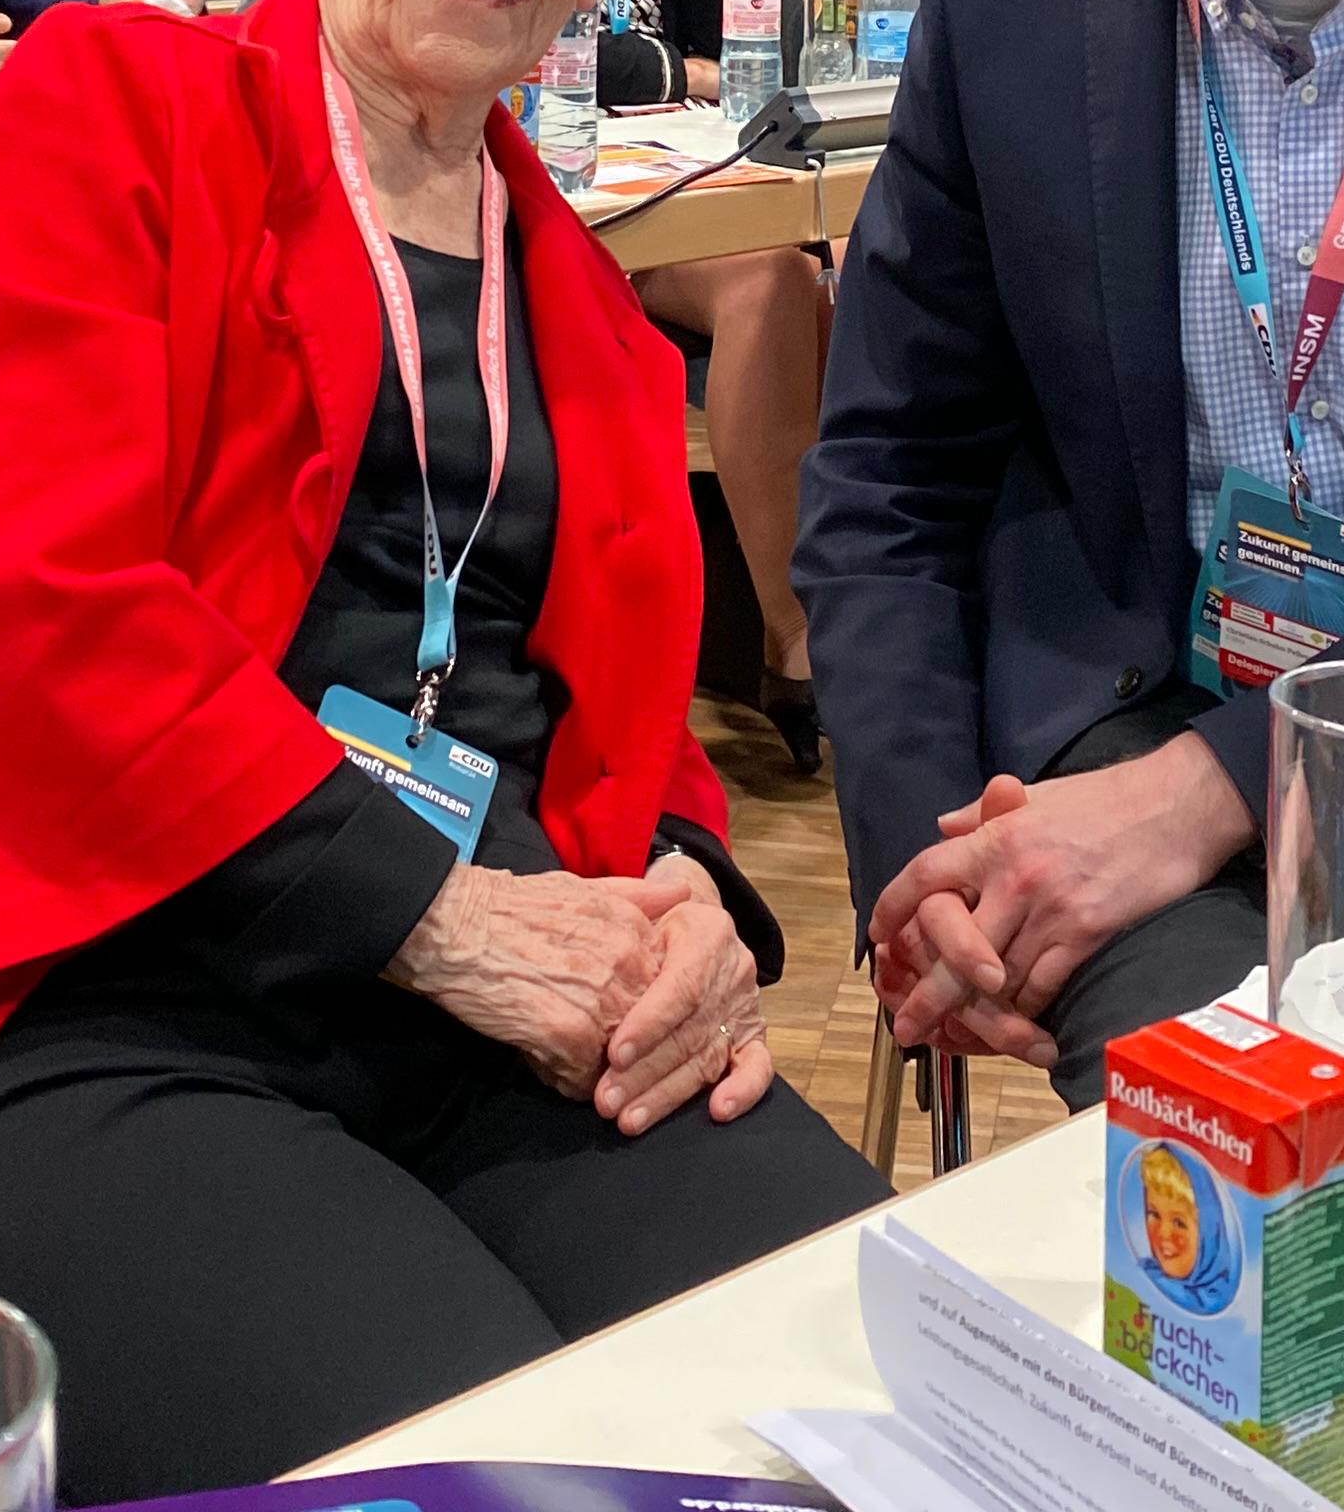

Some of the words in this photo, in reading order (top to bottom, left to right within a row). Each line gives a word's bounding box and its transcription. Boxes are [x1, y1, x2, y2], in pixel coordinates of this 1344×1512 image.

[1213, 130, 1229, 164] CDU
[354, 192, 385, 258] Soziale
[1220, 166, 1252, 272] Deutschlands
[1291, 314, 1326, 382] INSM
[1236, 546, 1305, 578] gewinnen.
[1238, 530, 1291, 558] Zukunft
[1227, 653, 1280, 680] Delegiert
[344, 744, 385, 777] kunft
[384, 767, 472, 819] gemeinsam
[460, 753, 492, 774] CDU
[1110, 1070, 1254, 1166] Rotbäckchen
[1137, 1301, 1225, 1368] Frucht-
[958, 1315, 1021, 1363] Augenhöhe
[1021, 1353, 1044, 1379] mit
[1043, 1366, 1067, 1393] den
[1067, 1379, 1142, 1436] Bürgerinnen
[1143, 1427, 1169, 1454] und
[1169, 1443, 1218, 1486] Bürgern
[1219, 1479, 1261, 1512] reden
[1028, 1394, 1073, 1434] Zukunft
[1074, 1422, 1096, 1447] der
[1094, 1435, 1134, 1470] Arbeit
[1133, 1458, 1158, 1487] und
